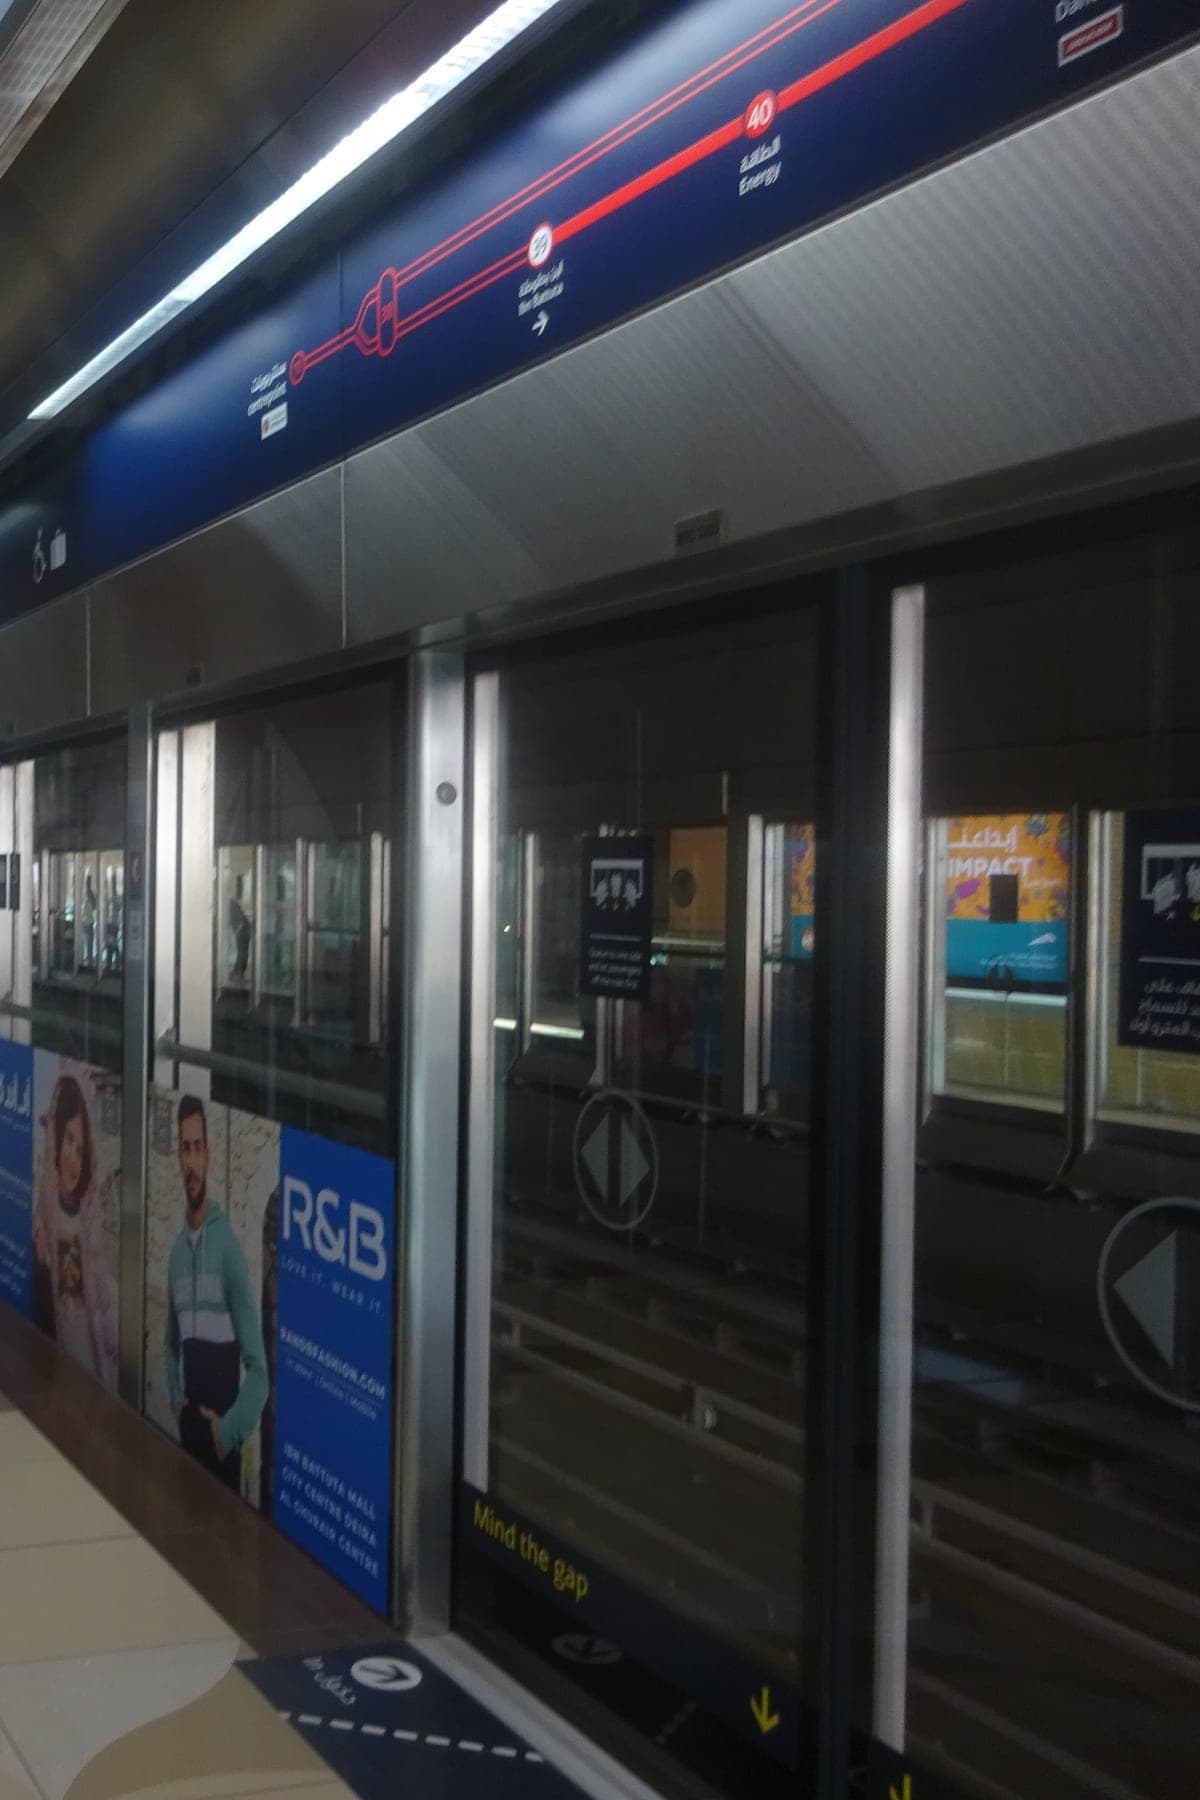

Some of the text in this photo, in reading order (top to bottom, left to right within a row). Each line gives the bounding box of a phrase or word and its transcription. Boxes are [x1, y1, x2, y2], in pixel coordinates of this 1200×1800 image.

[746, 97, 773, 130] 40
[738, 160, 782, 197] Energy
[946, 824, 1020, 857] إبداعن
[948, 855, 1034, 880] IMPACT
[282, 1174, 388, 1281] R&B
[283, 1440, 376, 1522] IBN BATTUTA MALL
[282, 1465, 377, 1550] CITY CENTRE DEIRA
[337, 1533, 379, 1579] CENTRE
[473, 1498, 591, 1606] Mind the gap
